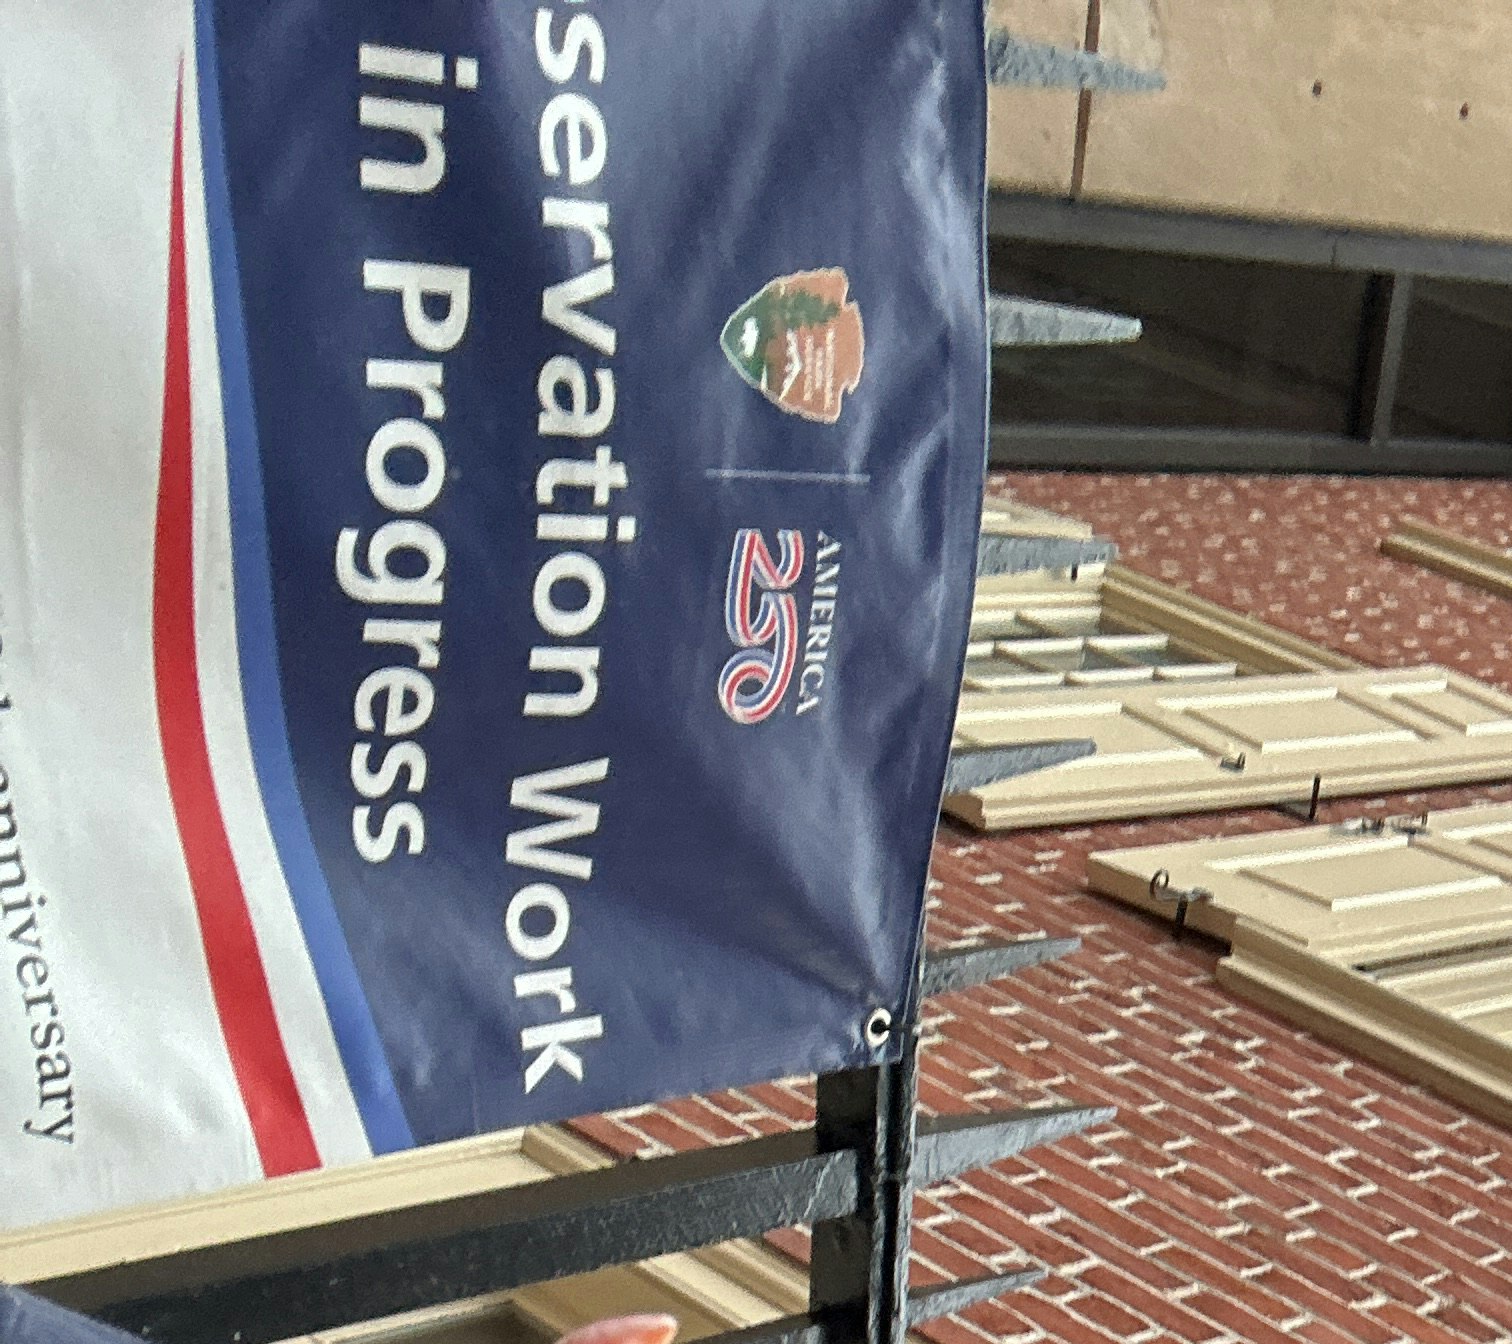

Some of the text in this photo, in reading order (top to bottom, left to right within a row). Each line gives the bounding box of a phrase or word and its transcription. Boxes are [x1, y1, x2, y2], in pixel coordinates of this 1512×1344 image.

[335, 41, 480, 864] in Progress
[503, 0, 637, 1094] servation Work
[718, 528, 805, 725] 250
[795, 529, 843, 716] AMERICA
[0, 763, 77, 1146] nniversary
